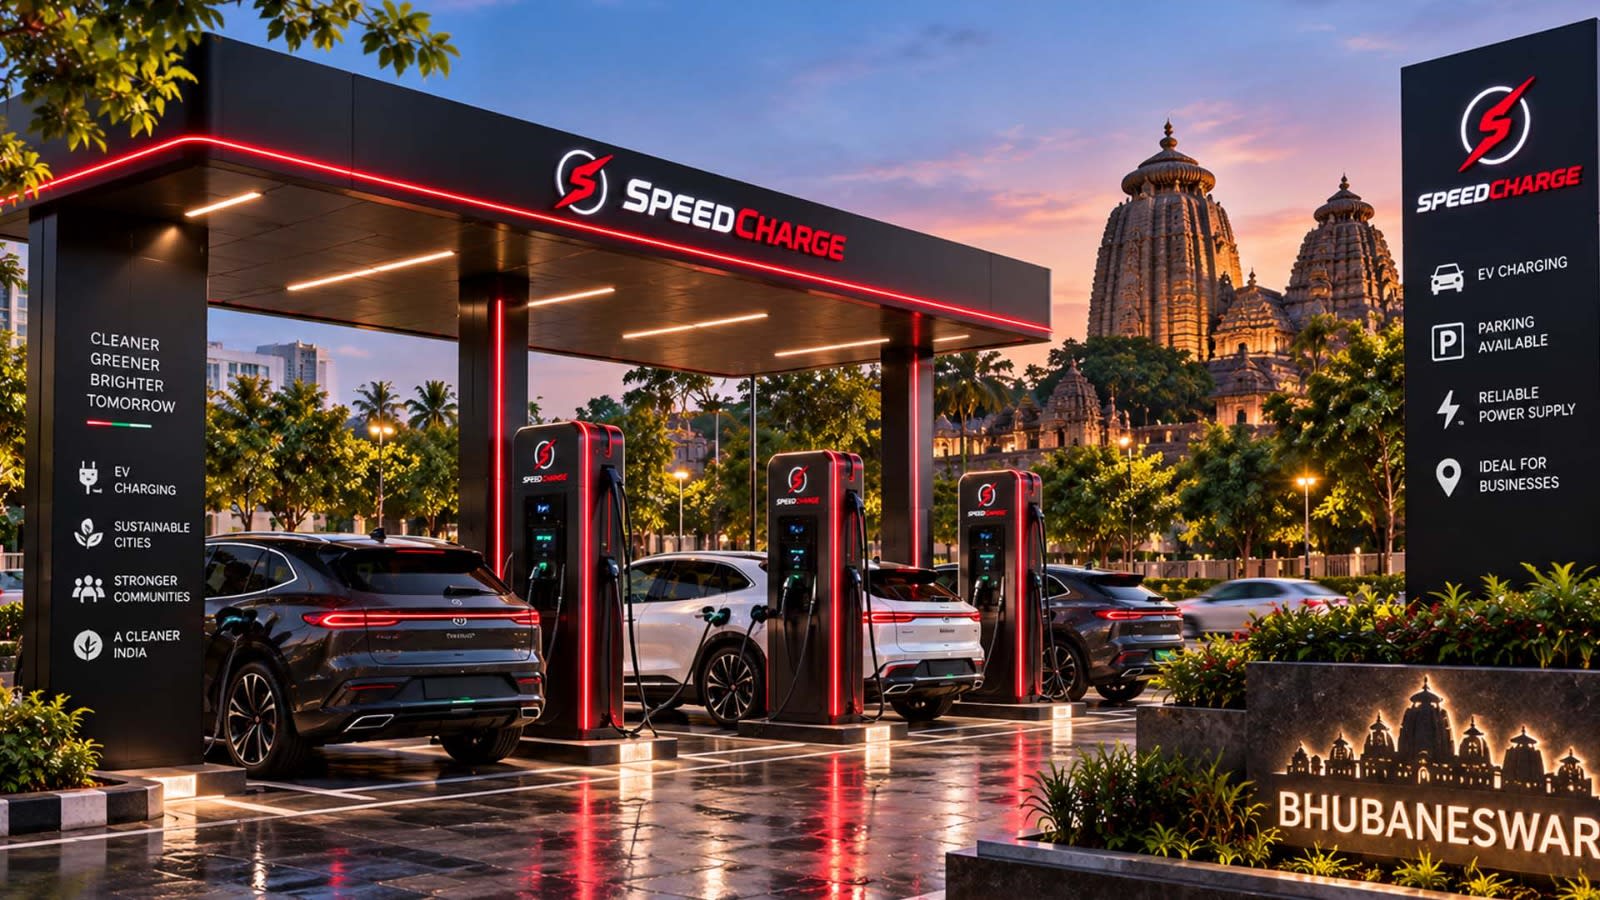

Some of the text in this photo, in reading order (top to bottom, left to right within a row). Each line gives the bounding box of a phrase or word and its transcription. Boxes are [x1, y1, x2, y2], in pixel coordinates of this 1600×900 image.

[1416, 165, 1583, 213] SPEEDCHARGE
[1478, 256, 1568, 281] EV CHARGING
[1478, 316, 1535, 334] PARKING
[90, 332, 160, 352] CLEANER
[1478, 333, 1548, 354] AVAILABLE
[90, 353, 160, 372] GREENER
[90, 374, 164, 392] BRIGHTER
[87, 394, 176, 413] TOMORROW
[1479, 387, 1539, 404] RELIABLE
[1479, 403, 1576, 423] POWER SUPPLY
[114, 466, 130, 478] EV
[1479, 457, 1547, 473] IDEAL FOR
[114, 483, 177, 496] CHARGING
[1479, 476, 1560, 493] BUSINESSES
[114, 521, 190, 533] SUSTAINABLE
[114, 537, 152, 549] CITIES
[114, 576, 178, 587] STRONGER
[113, 592, 191, 603] COMMUNITIES
[114, 631, 181, 642] A CLEANER
[114, 648, 147, 659] INDIA
[1278, 791, 1600, 859] BHUBANESWAR
